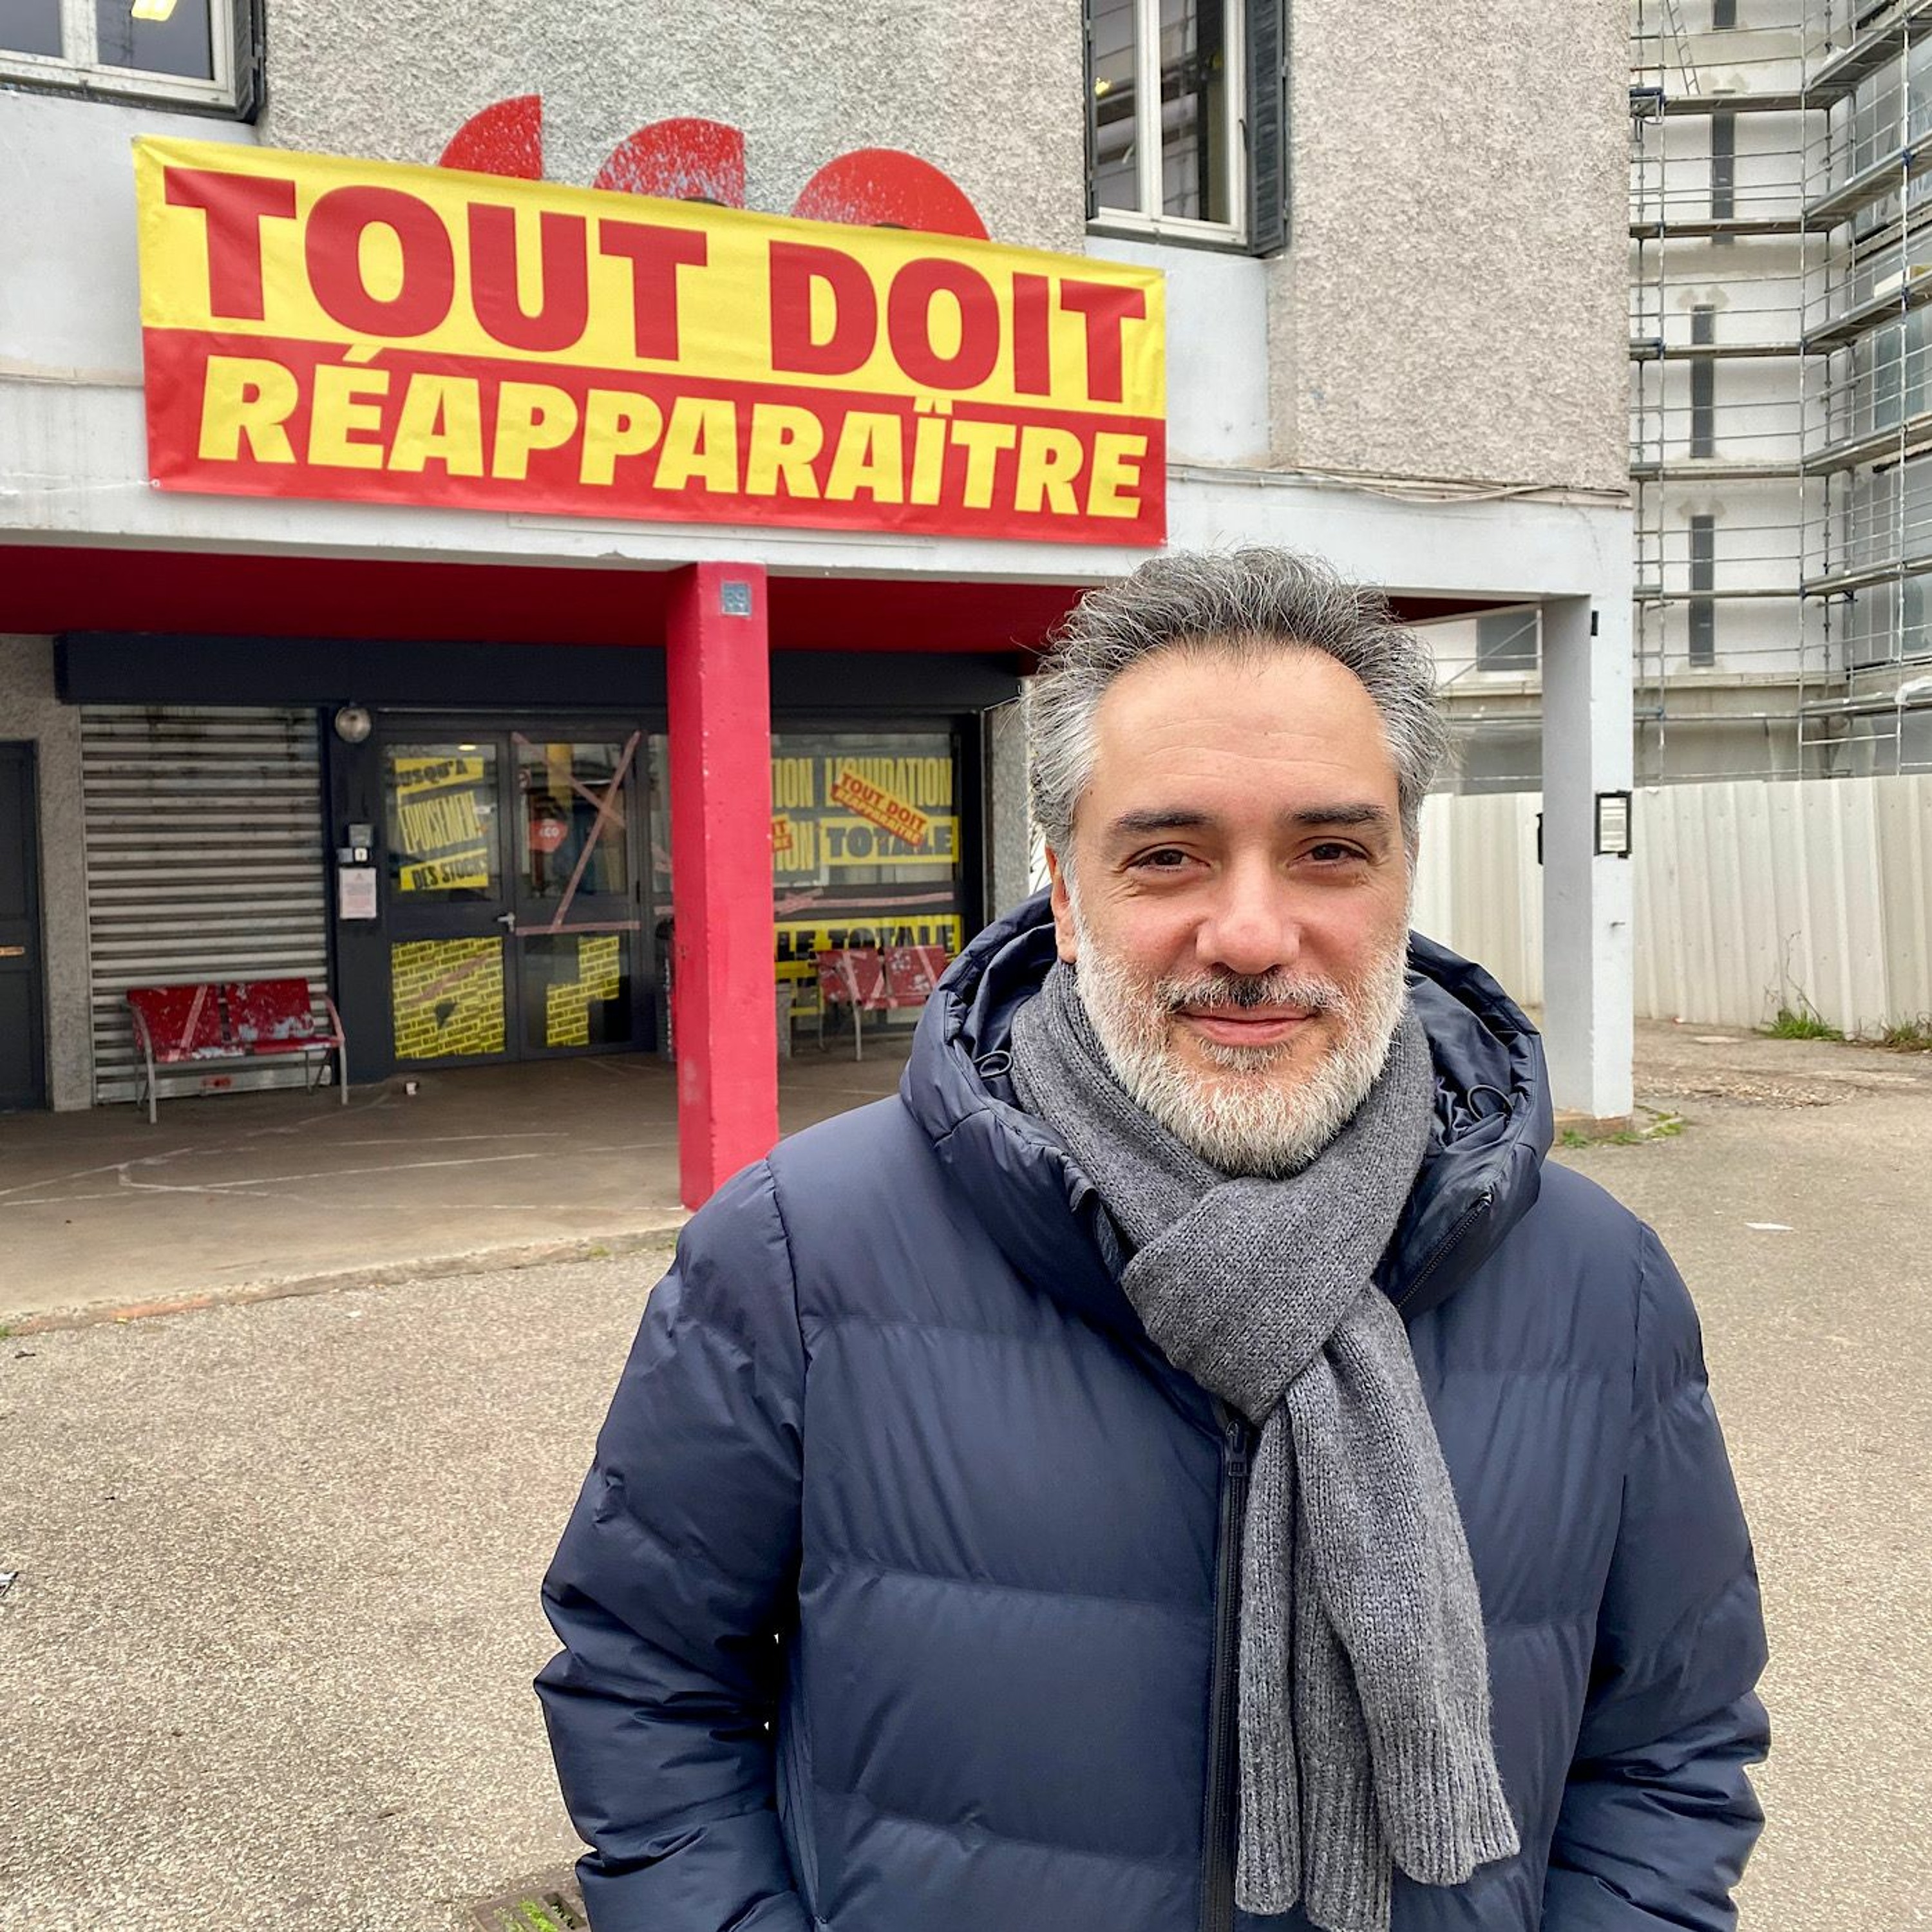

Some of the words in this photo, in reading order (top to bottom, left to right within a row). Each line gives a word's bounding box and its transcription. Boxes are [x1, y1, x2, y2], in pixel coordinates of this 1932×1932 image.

[164, 166, 707, 362] TOUT
[768, 240, 1146, 403] DOIT
[825, 757, 952, 808] LDATION
[842, 772, 885, 805] TOUT
[886, 799, 927, 831] DOIT
[412, 865, 439, 890] DES
